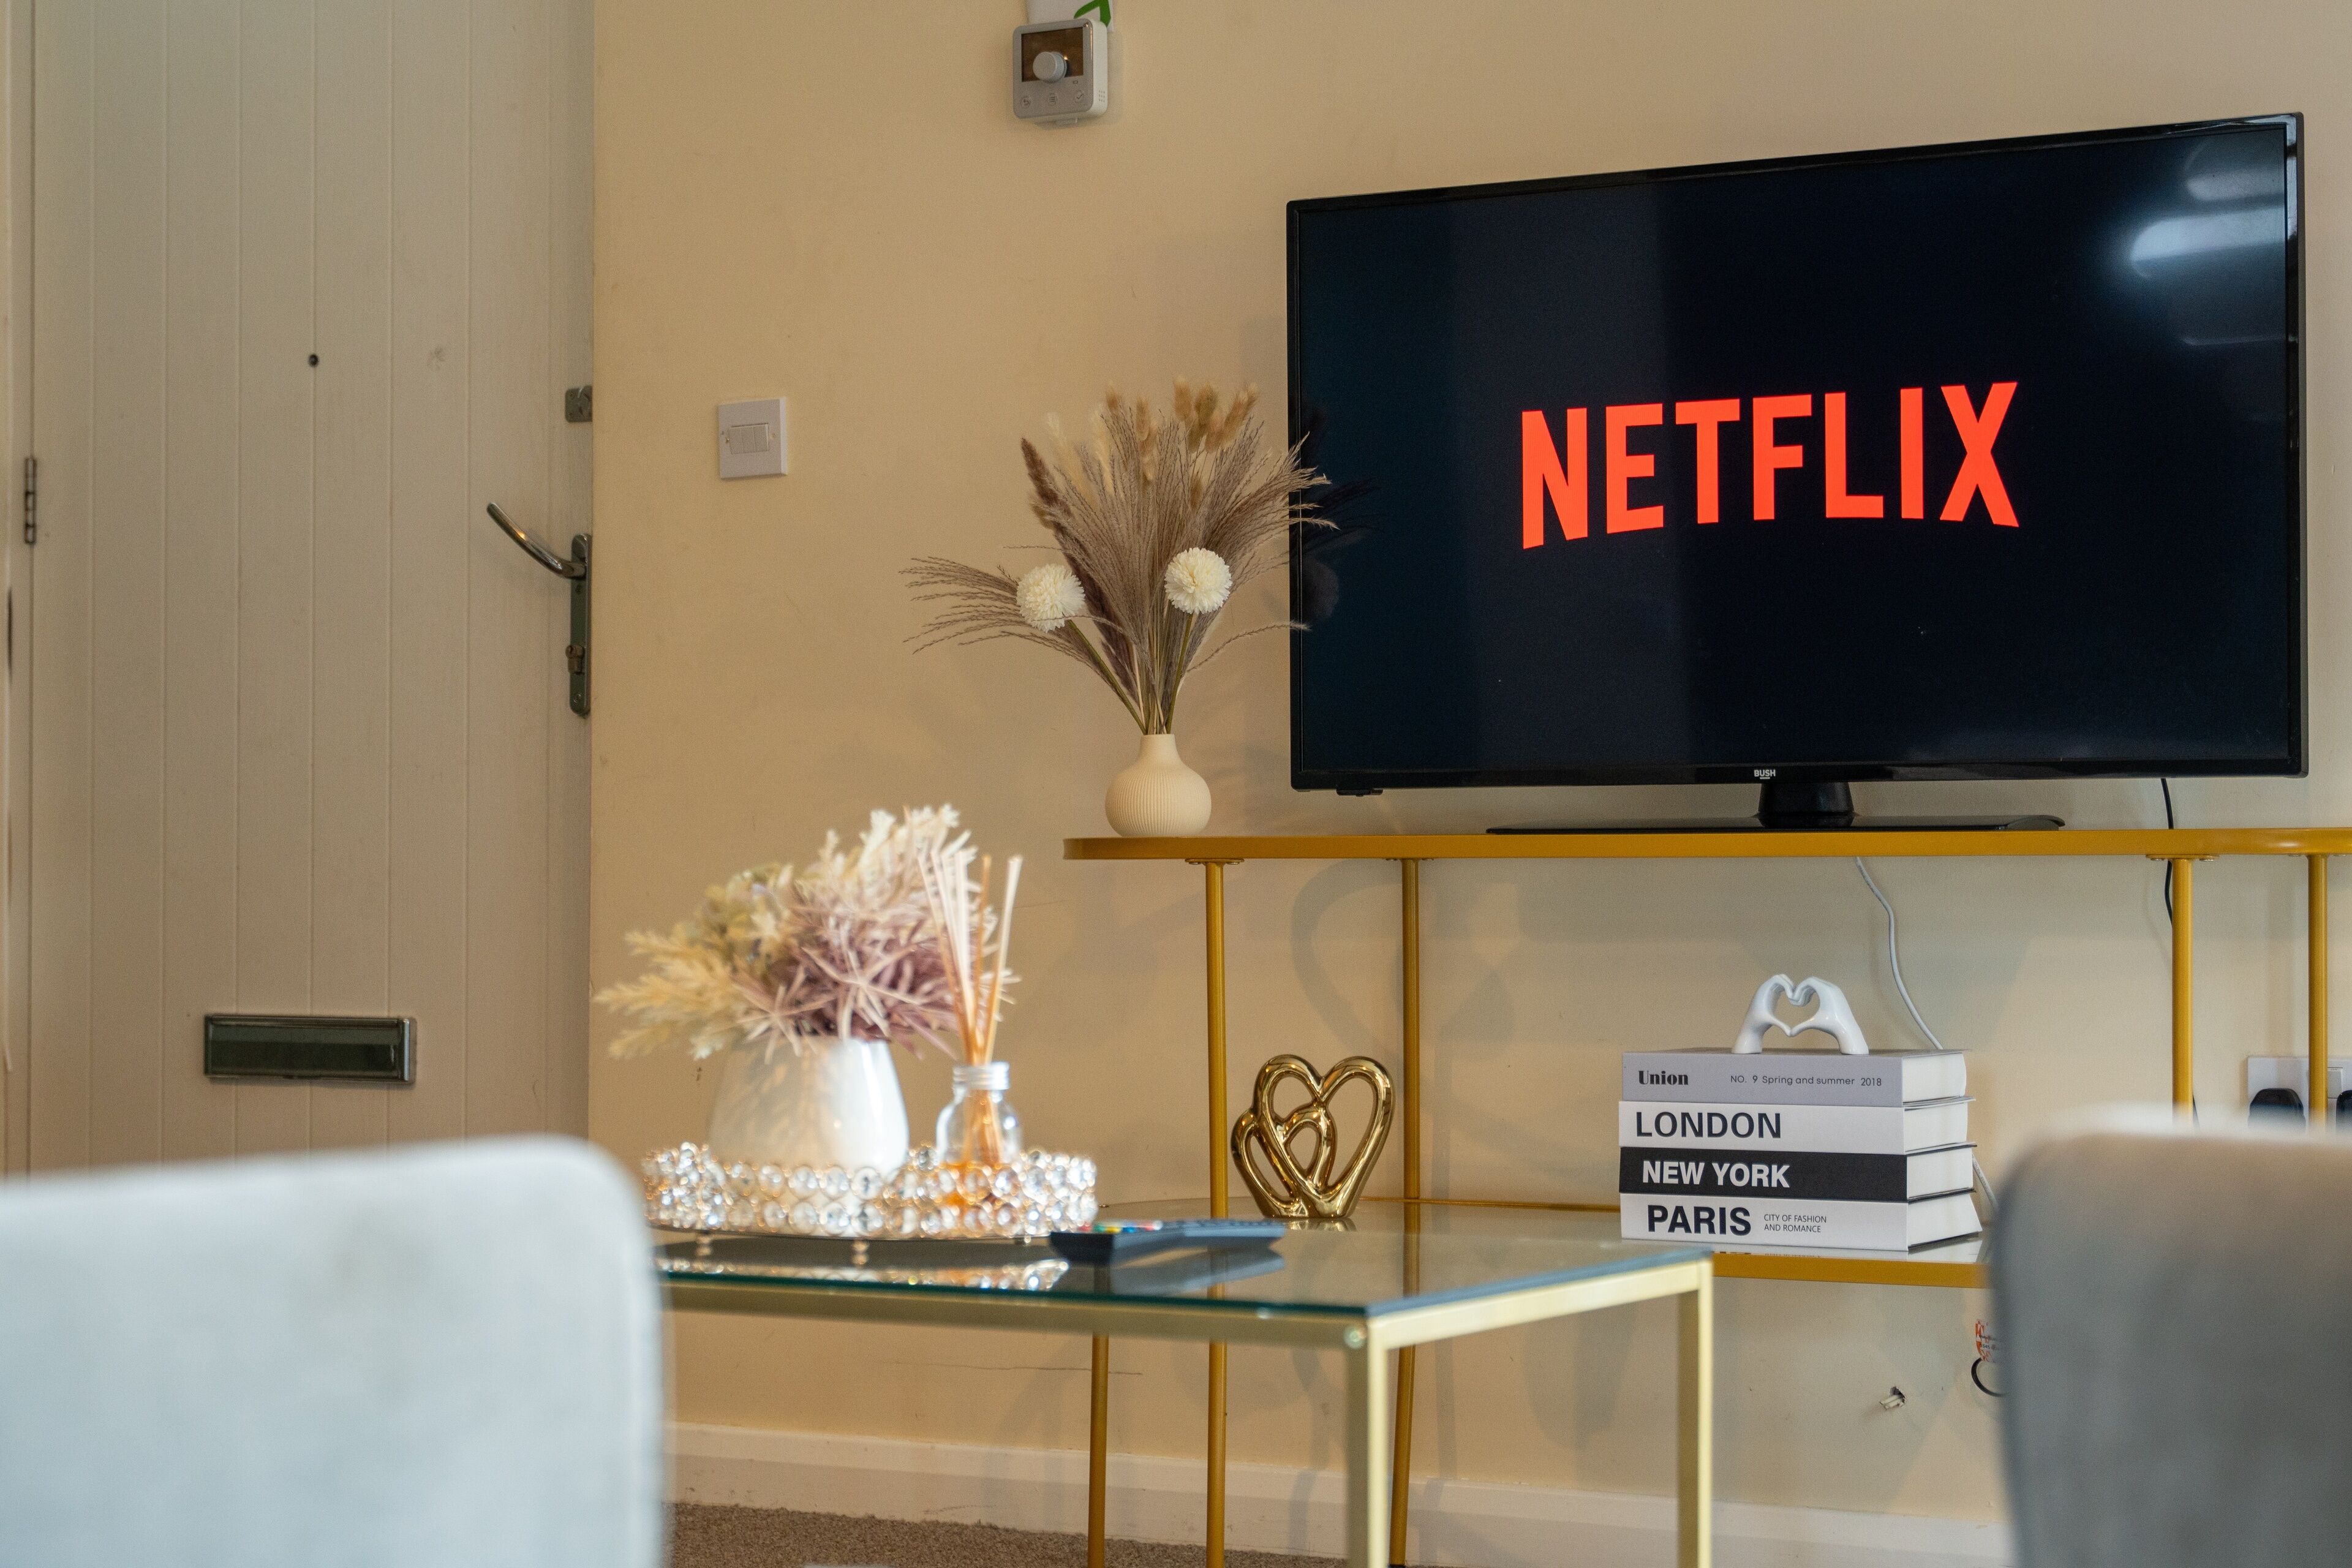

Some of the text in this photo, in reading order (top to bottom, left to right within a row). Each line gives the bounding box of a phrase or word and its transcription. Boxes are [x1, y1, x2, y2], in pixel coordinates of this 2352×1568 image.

[1522, 382, 2019, 549] NETFLIX
[1638, 1070, 1689, 1085] Union
[1730, 1075, 1747, 1084] NO.
[1752, 1075, 1758, 1084] 9
[1762, 1076, 1793, 1086] Spring
[1795, 1076, 1814, 1085] and
[1861, 1077, 1882, 1087] 2018
[1636, 1112, 1781, 1139] LONDON
[1642, 1160, 1790, 1188] NEW YORK
[1647, 1204, 1752, 1237] PARIS
[1783, 1224, 1821, 1233] ROMANCE
